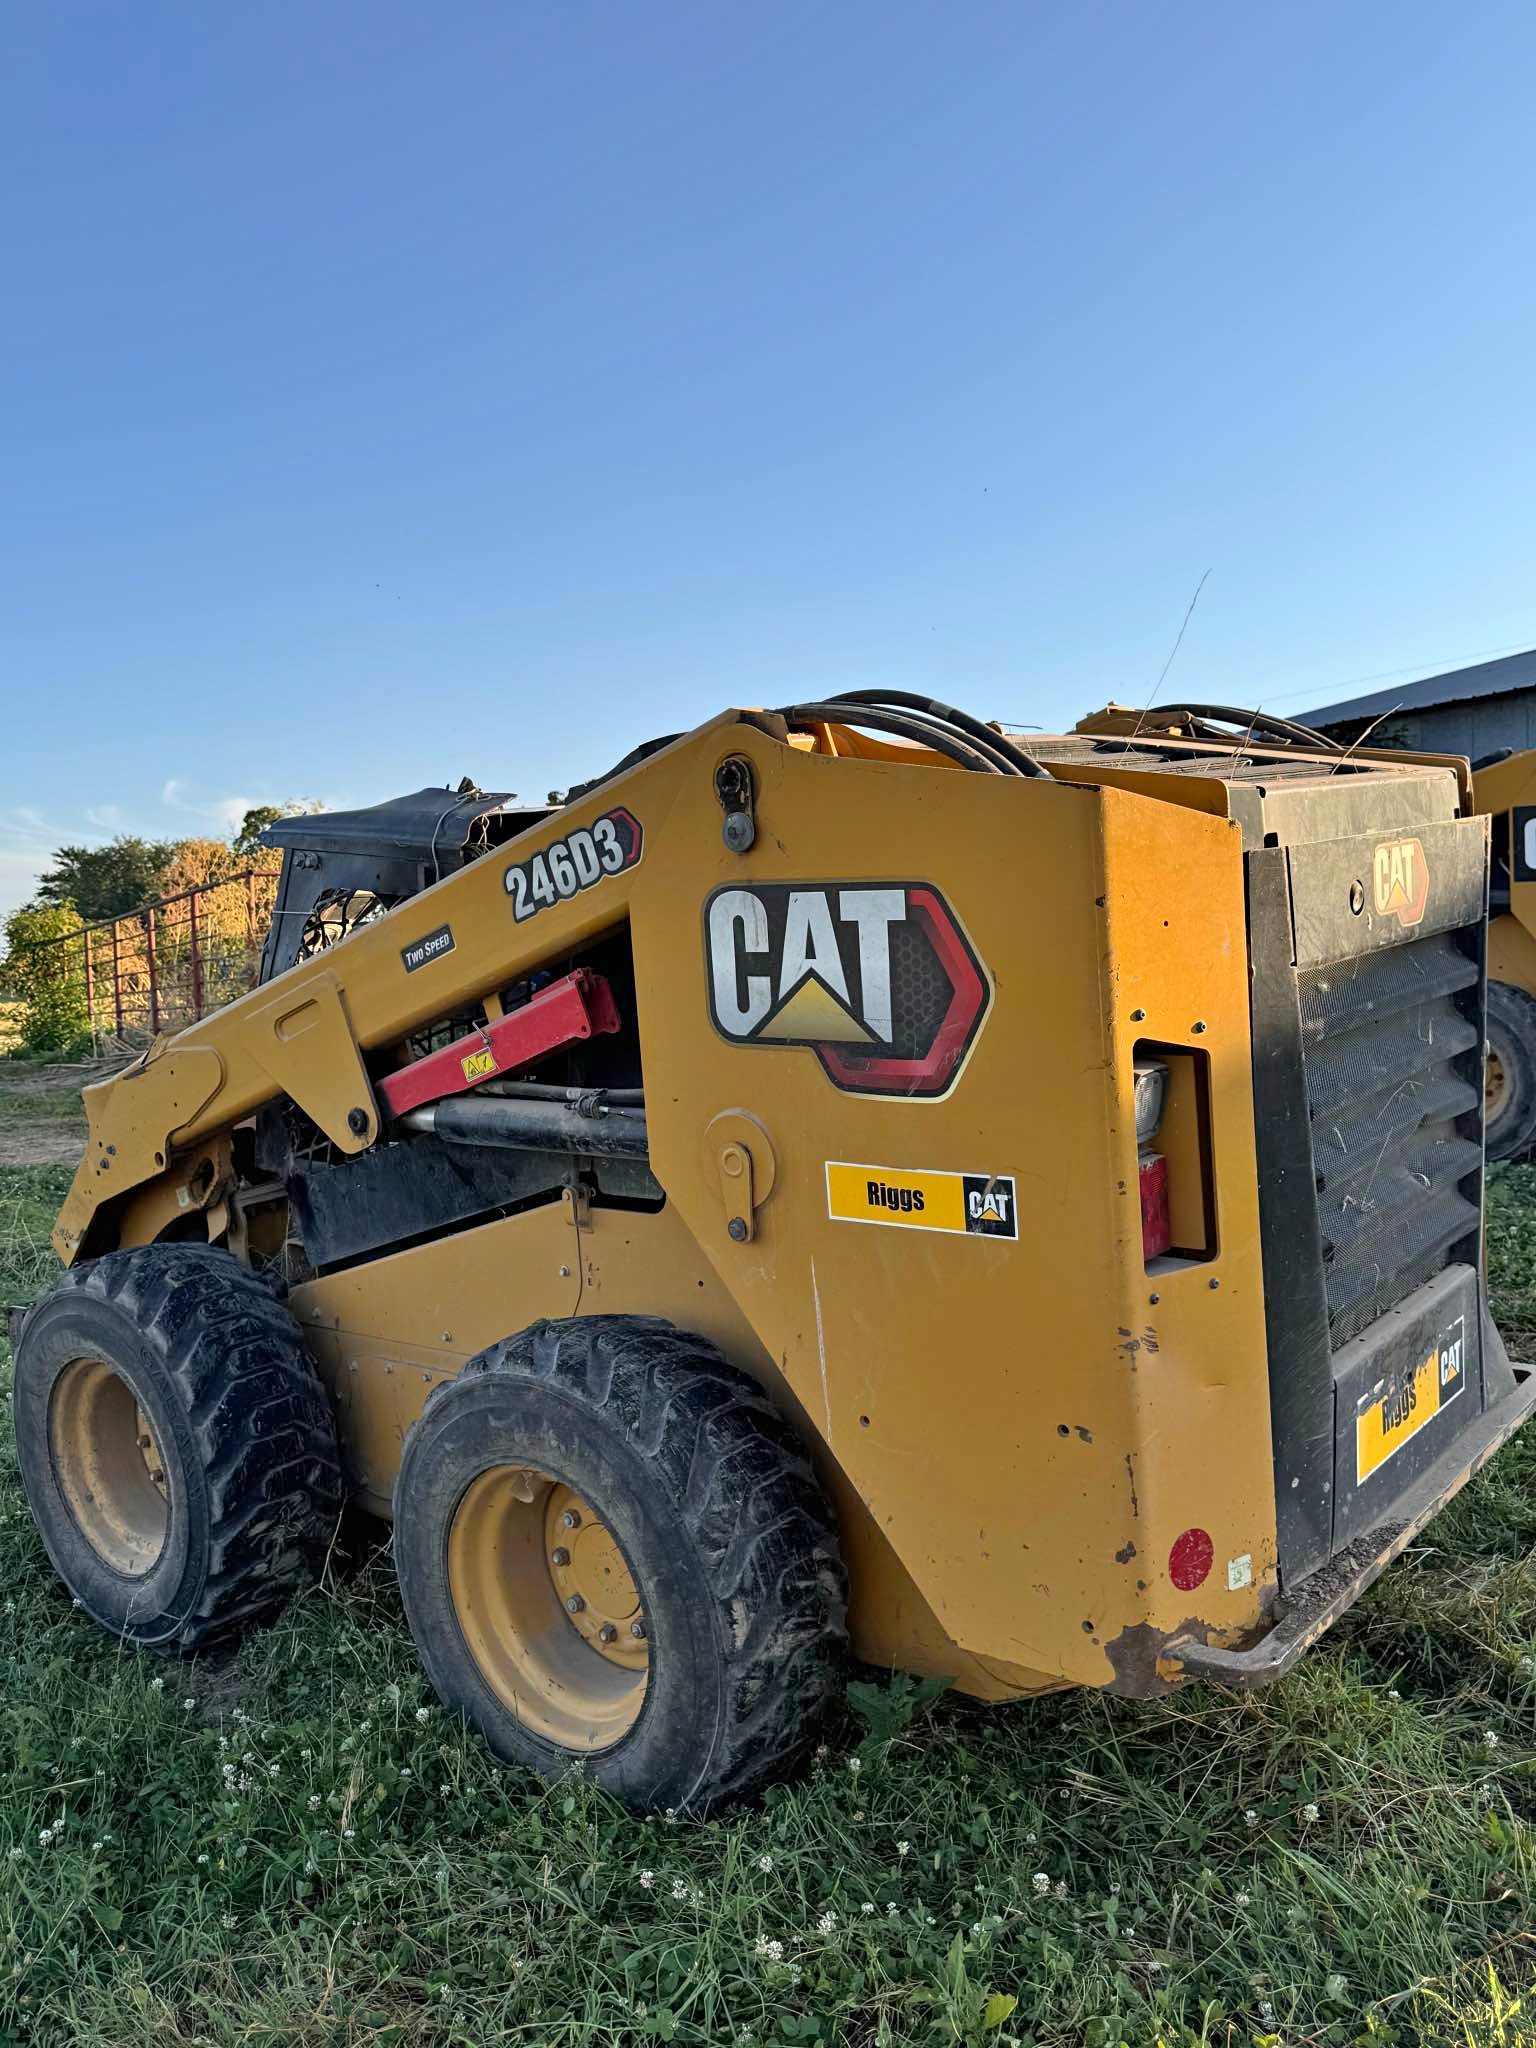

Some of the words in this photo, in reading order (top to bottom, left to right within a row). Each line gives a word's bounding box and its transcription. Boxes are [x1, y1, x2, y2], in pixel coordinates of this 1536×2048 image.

[505, 818, 624, 922] 246D3
[1374, 843, 1415, 911] CAT
[708, 889, 907, 1043] CAT
[866, 1181, 925, 1212] Riggs
[968, 1190, 1010, 1222] CAT
[1440, 1339, 1462, 1387] CAT
